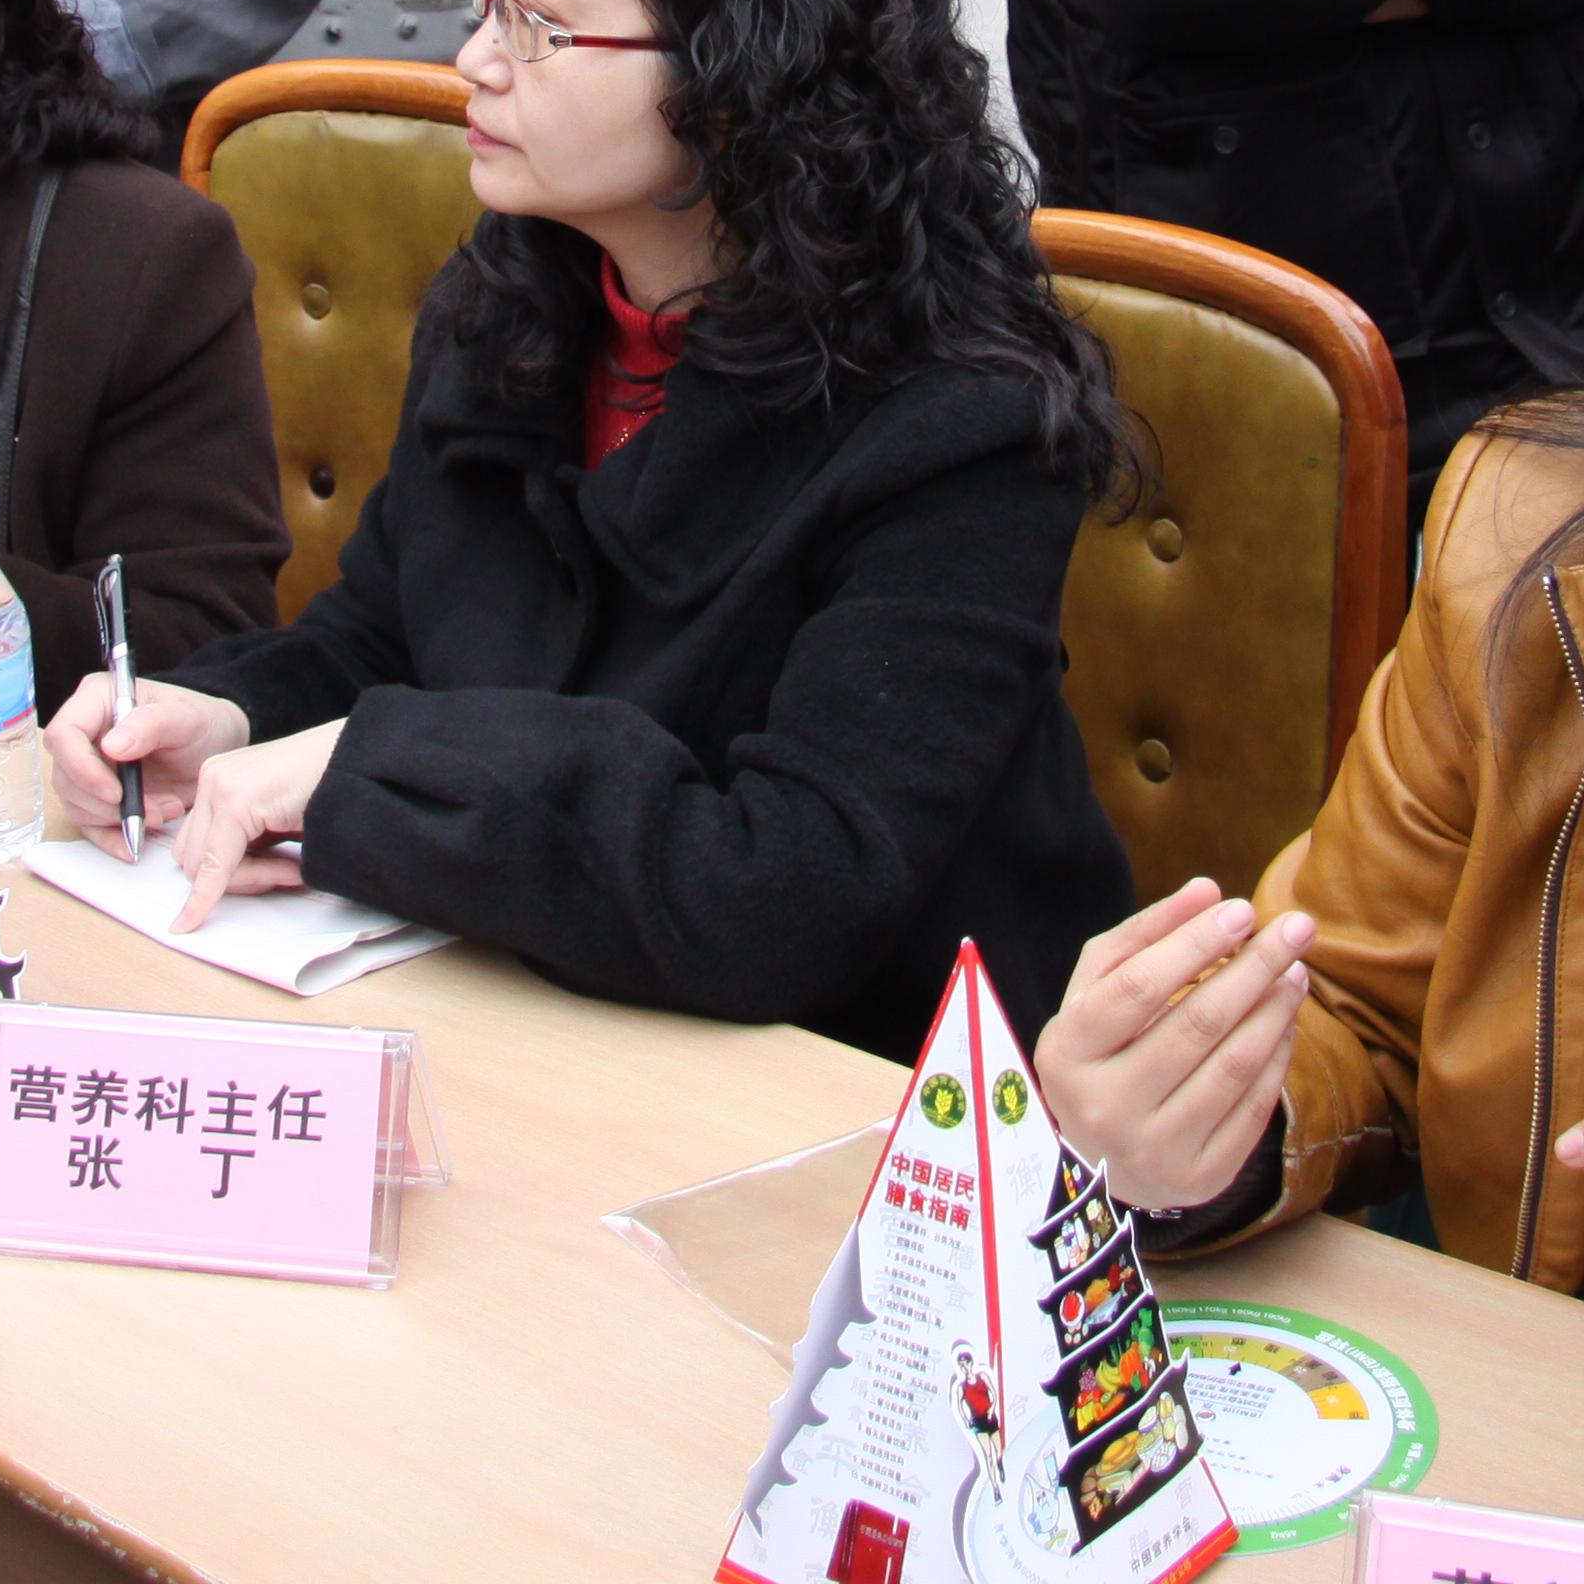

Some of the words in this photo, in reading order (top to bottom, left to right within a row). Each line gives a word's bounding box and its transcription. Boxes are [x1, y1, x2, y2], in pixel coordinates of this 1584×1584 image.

[10, 1064, 327, 1142] 营养科主任
[68, 1134, 124, 1190] 张
[200, 1145, 256, 1200] 丁
[891, 1152, 976, 1203] 中国居民
[884, 1178, 972, 1232] 膳食指南
